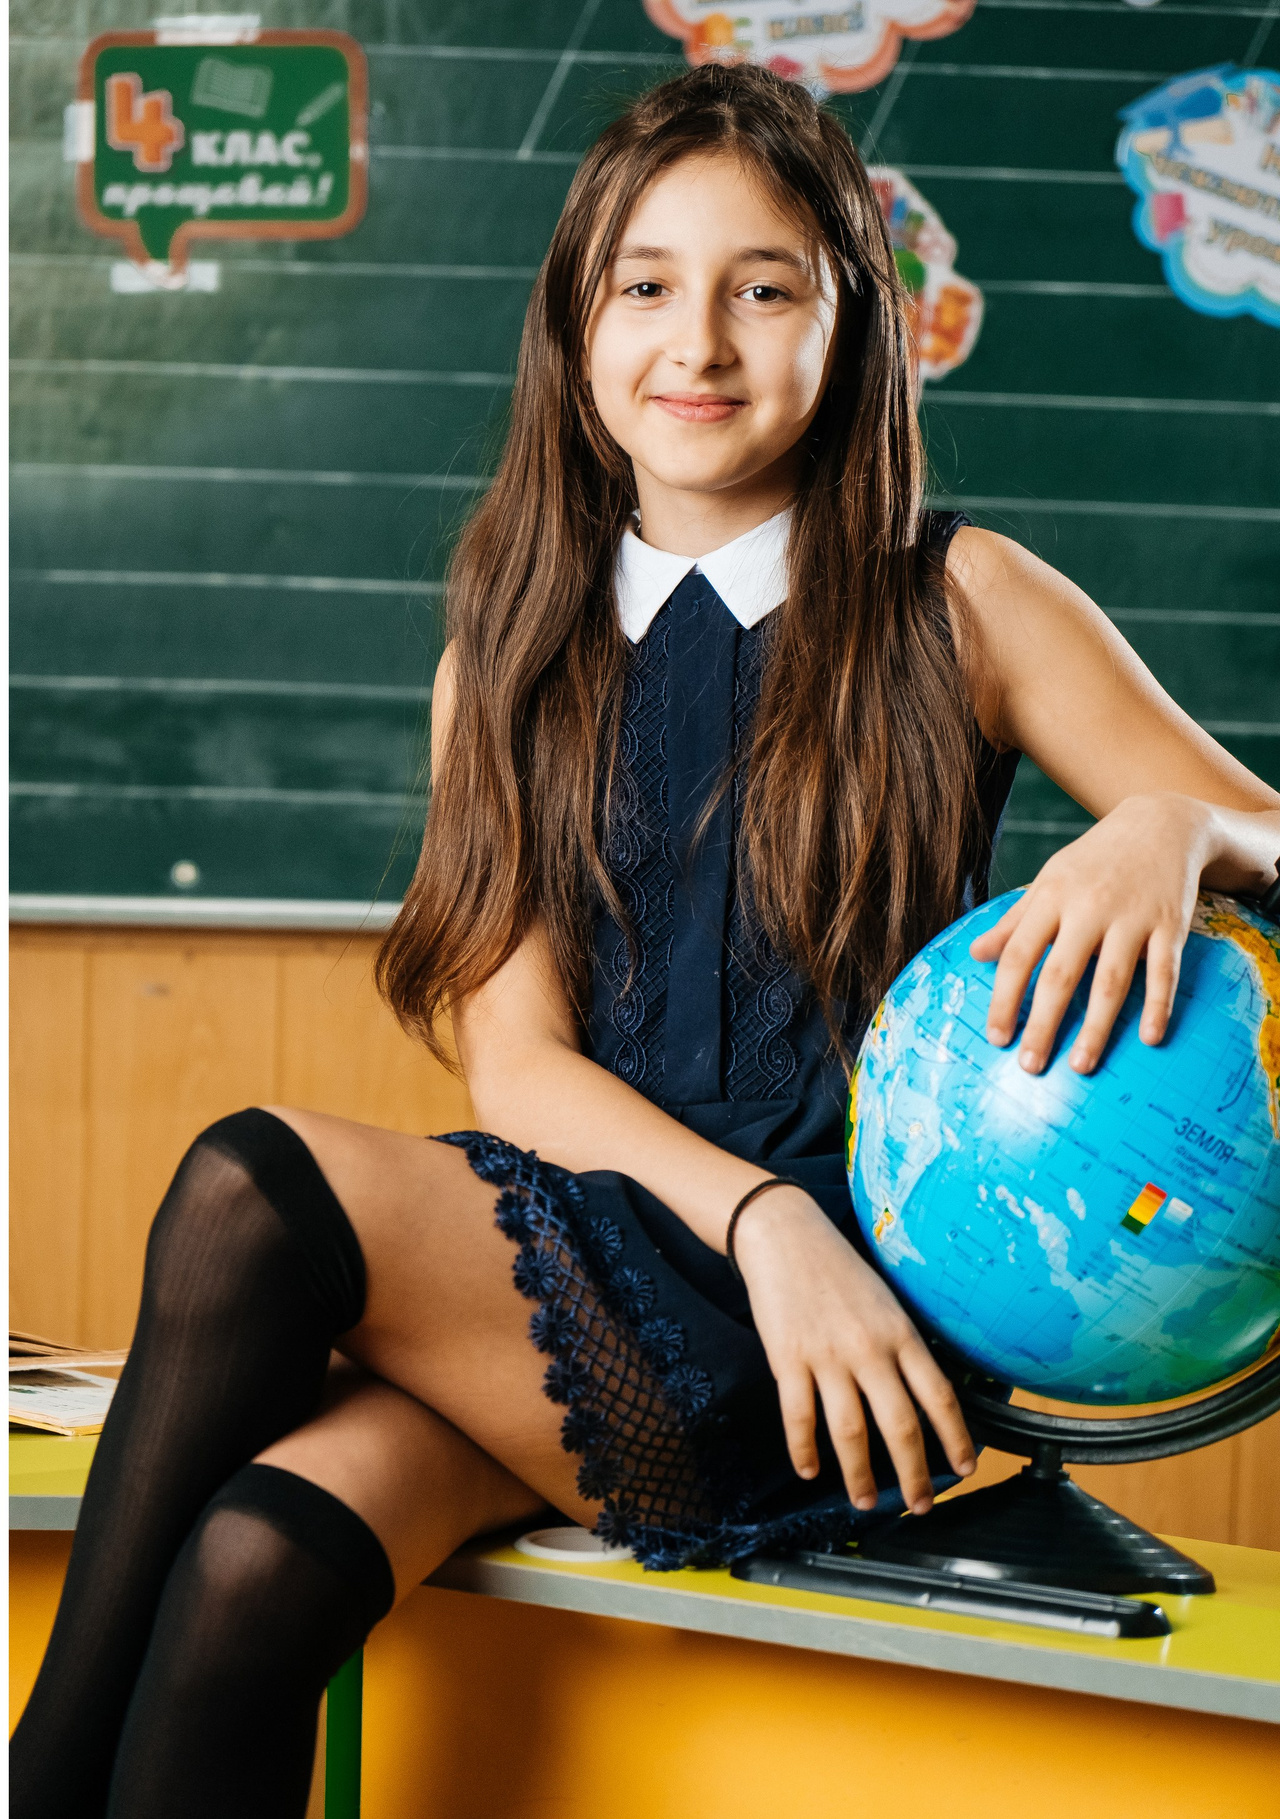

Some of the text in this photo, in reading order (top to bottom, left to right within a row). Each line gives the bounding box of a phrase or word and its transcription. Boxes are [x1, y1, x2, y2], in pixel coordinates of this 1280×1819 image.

[106, 71, 185, 173] 4
[102, 173, 334, 216] прощавай!
[1174, 1116, 1236, 1164] ЗЕМЛЯ
